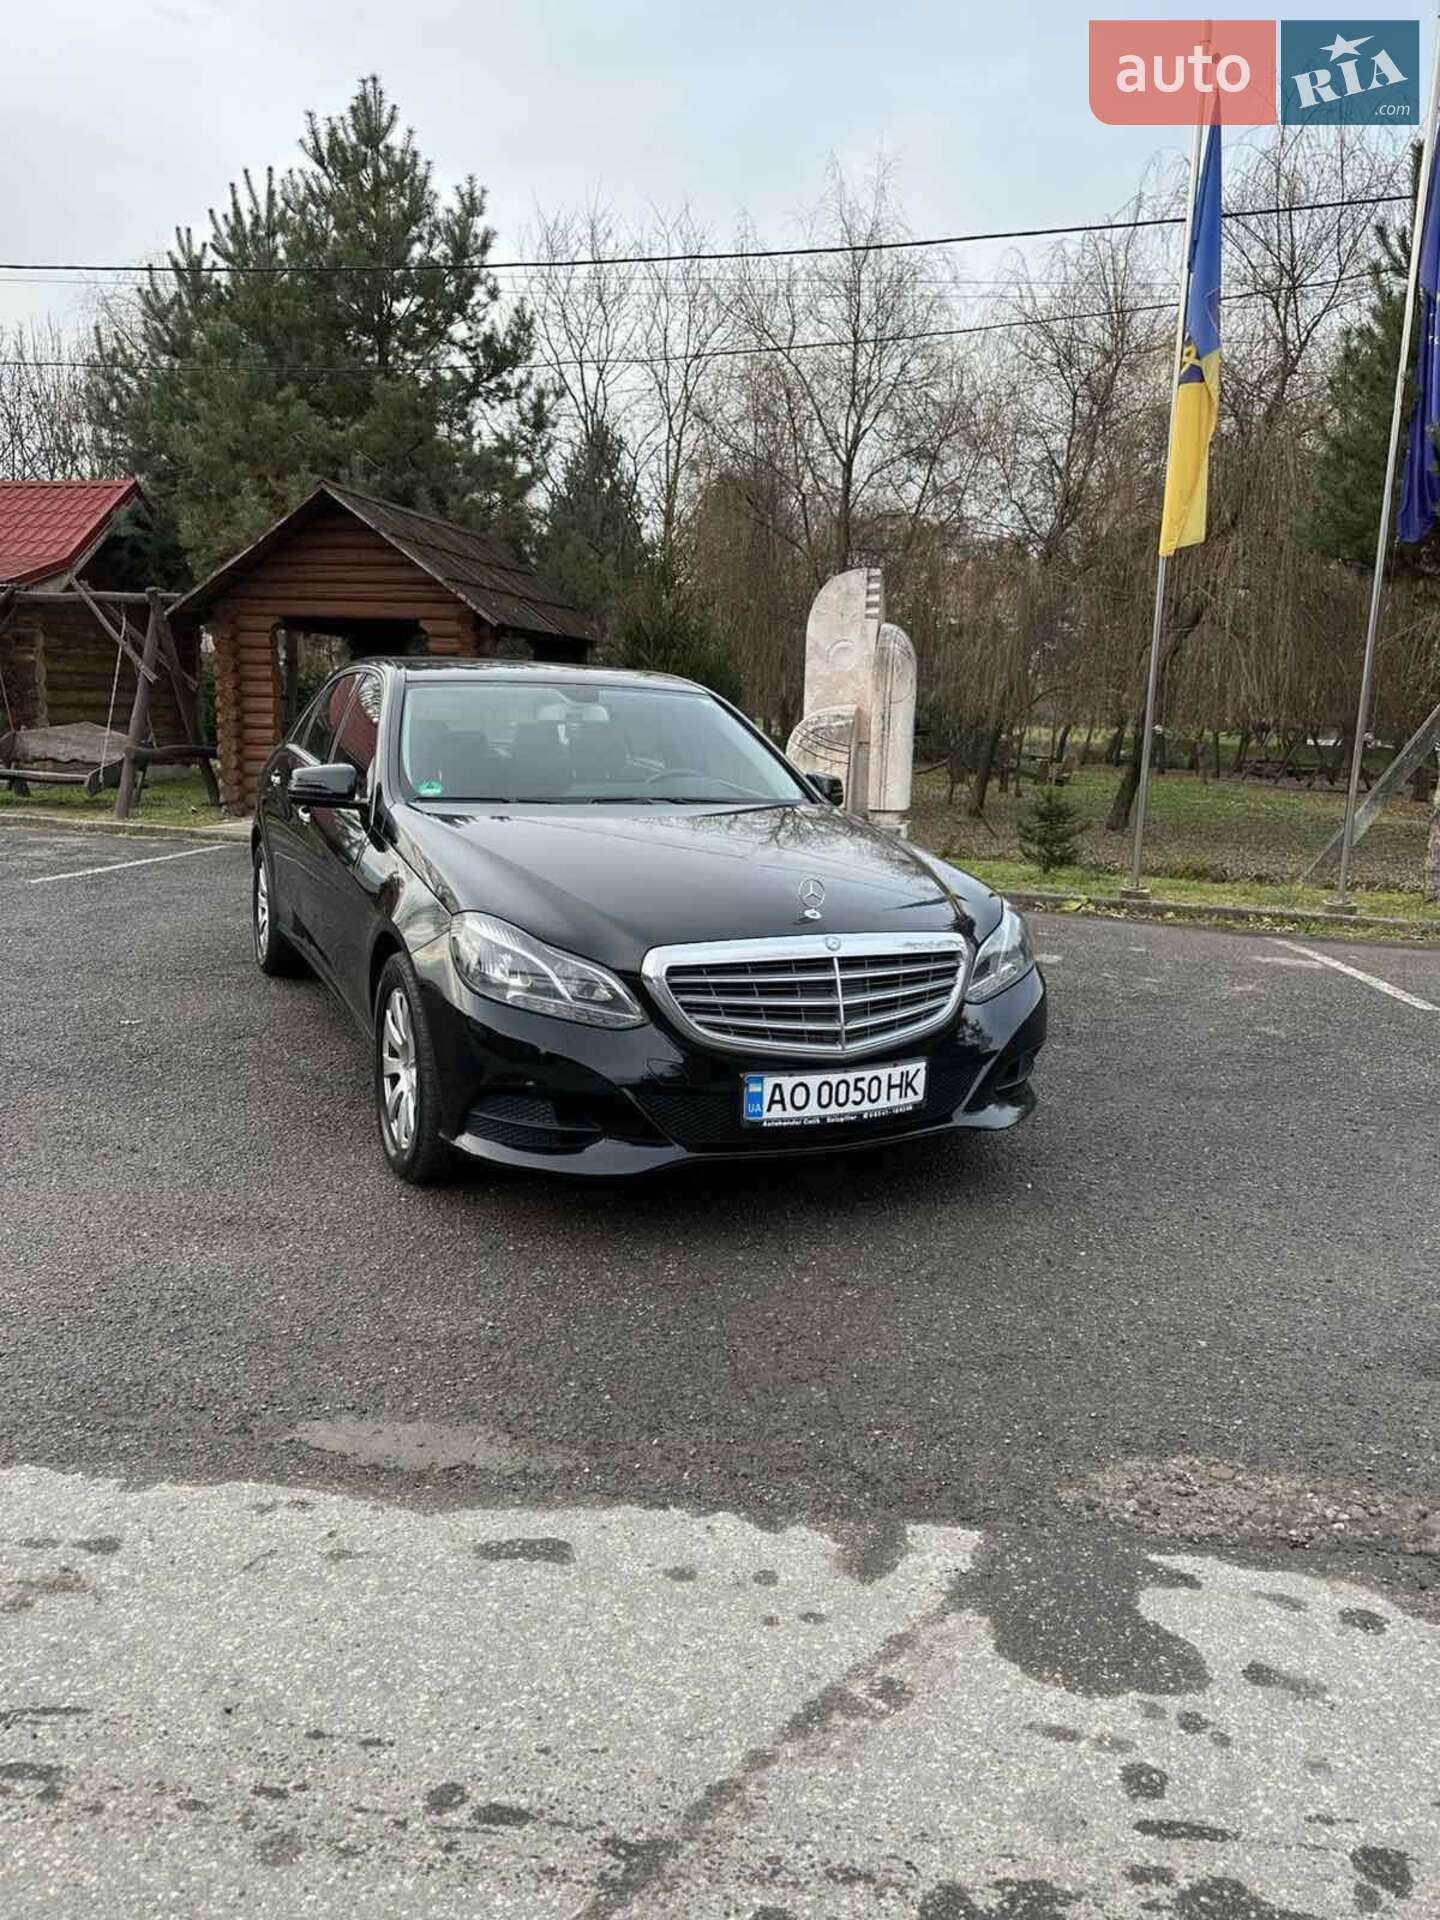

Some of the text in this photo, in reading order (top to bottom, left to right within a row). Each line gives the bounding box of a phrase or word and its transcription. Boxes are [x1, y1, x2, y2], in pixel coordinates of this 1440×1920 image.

[766, 1068, 921, 1113] AO 0050 HK
[748, 1103, 762, 1114] UA
